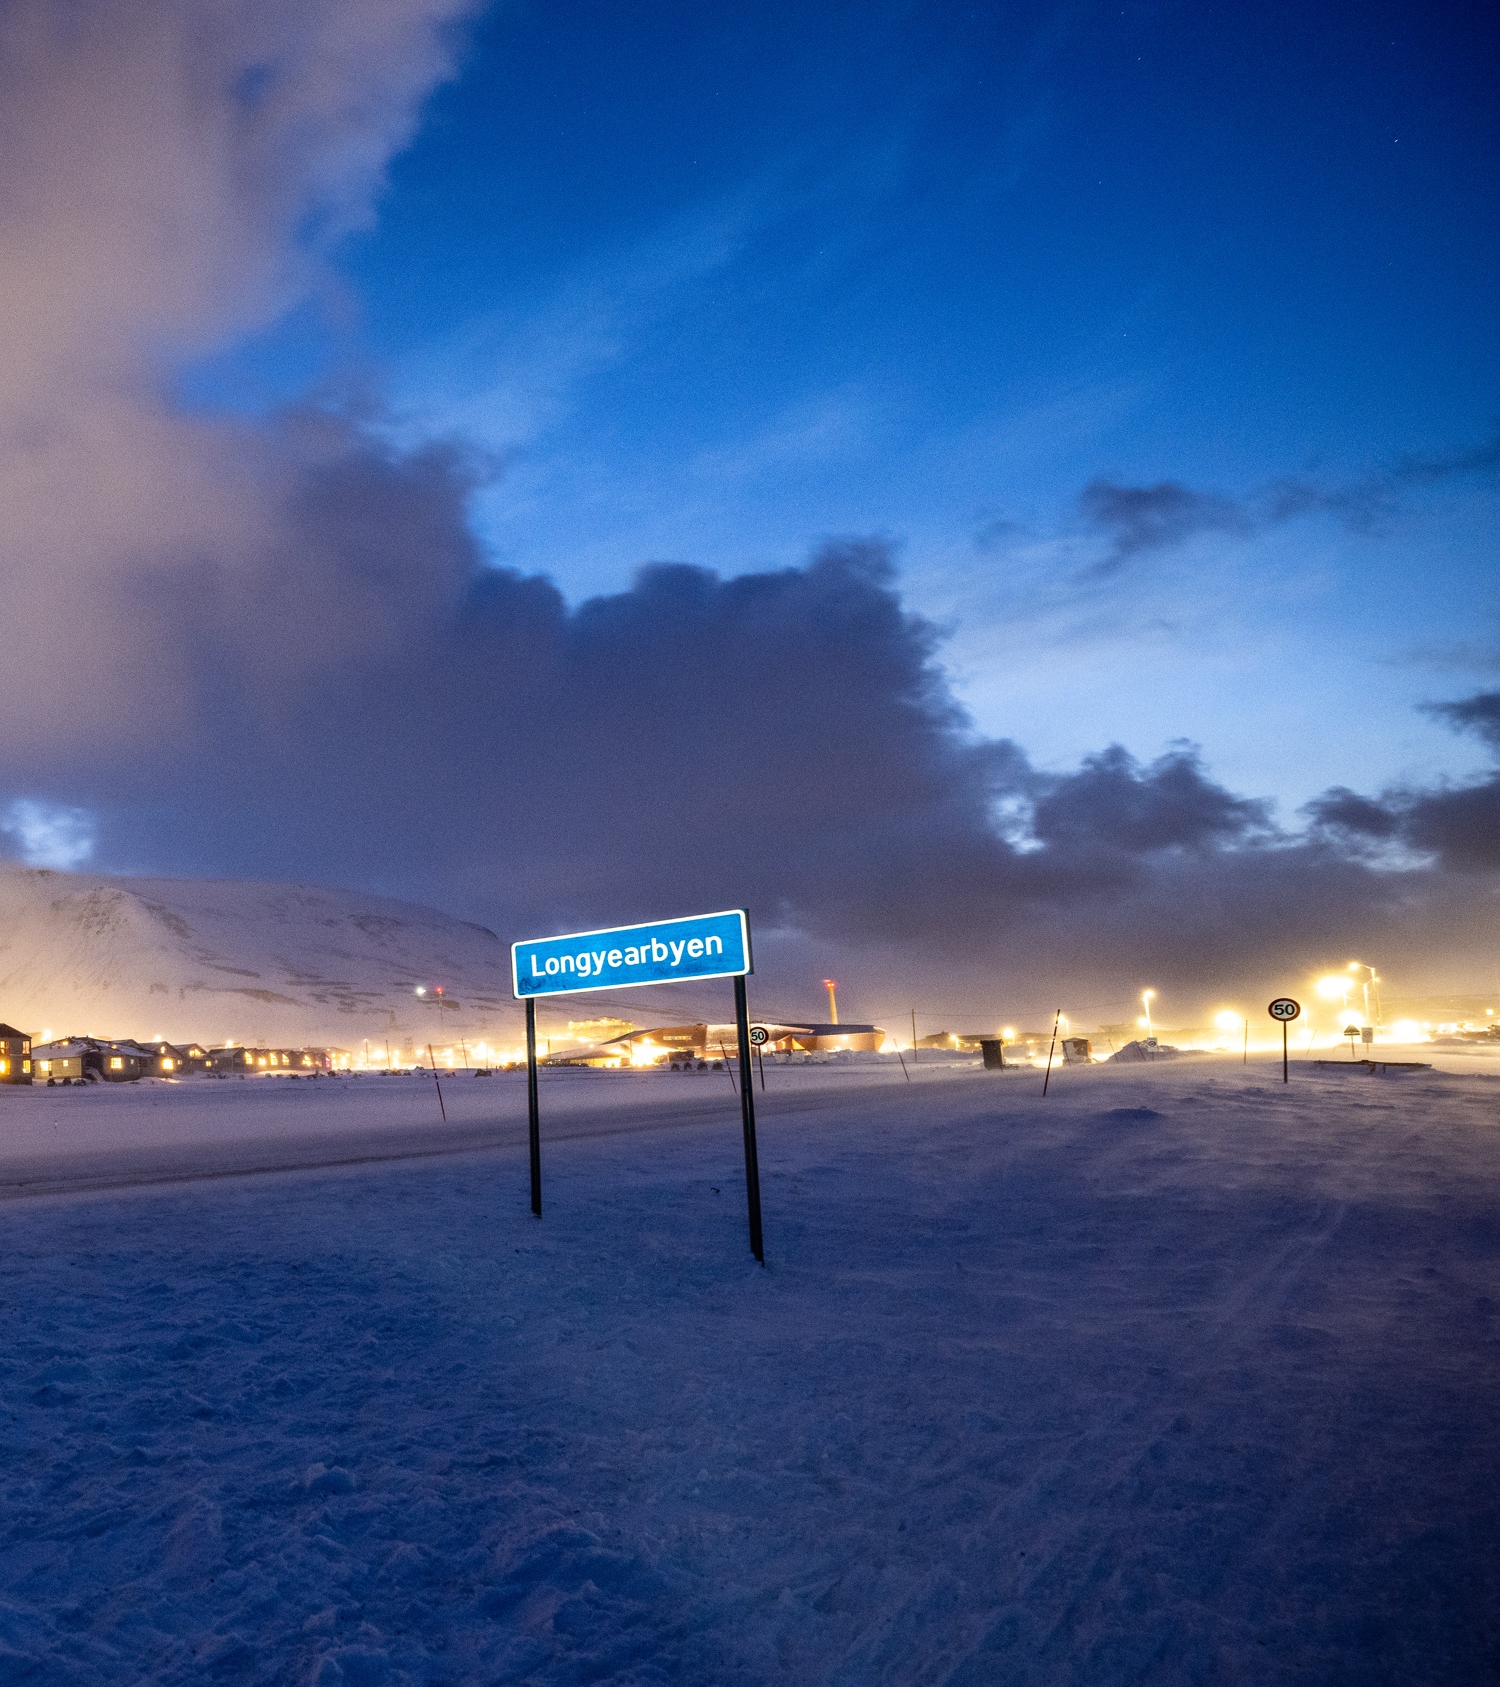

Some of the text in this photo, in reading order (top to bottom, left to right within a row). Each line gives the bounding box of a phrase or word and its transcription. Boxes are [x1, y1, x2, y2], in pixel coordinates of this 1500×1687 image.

[531, 935, 723, 978] Longyearbyen
[1274, 1004, 1295, 1016] 50
[751, 1031, 765, 1041] 50
